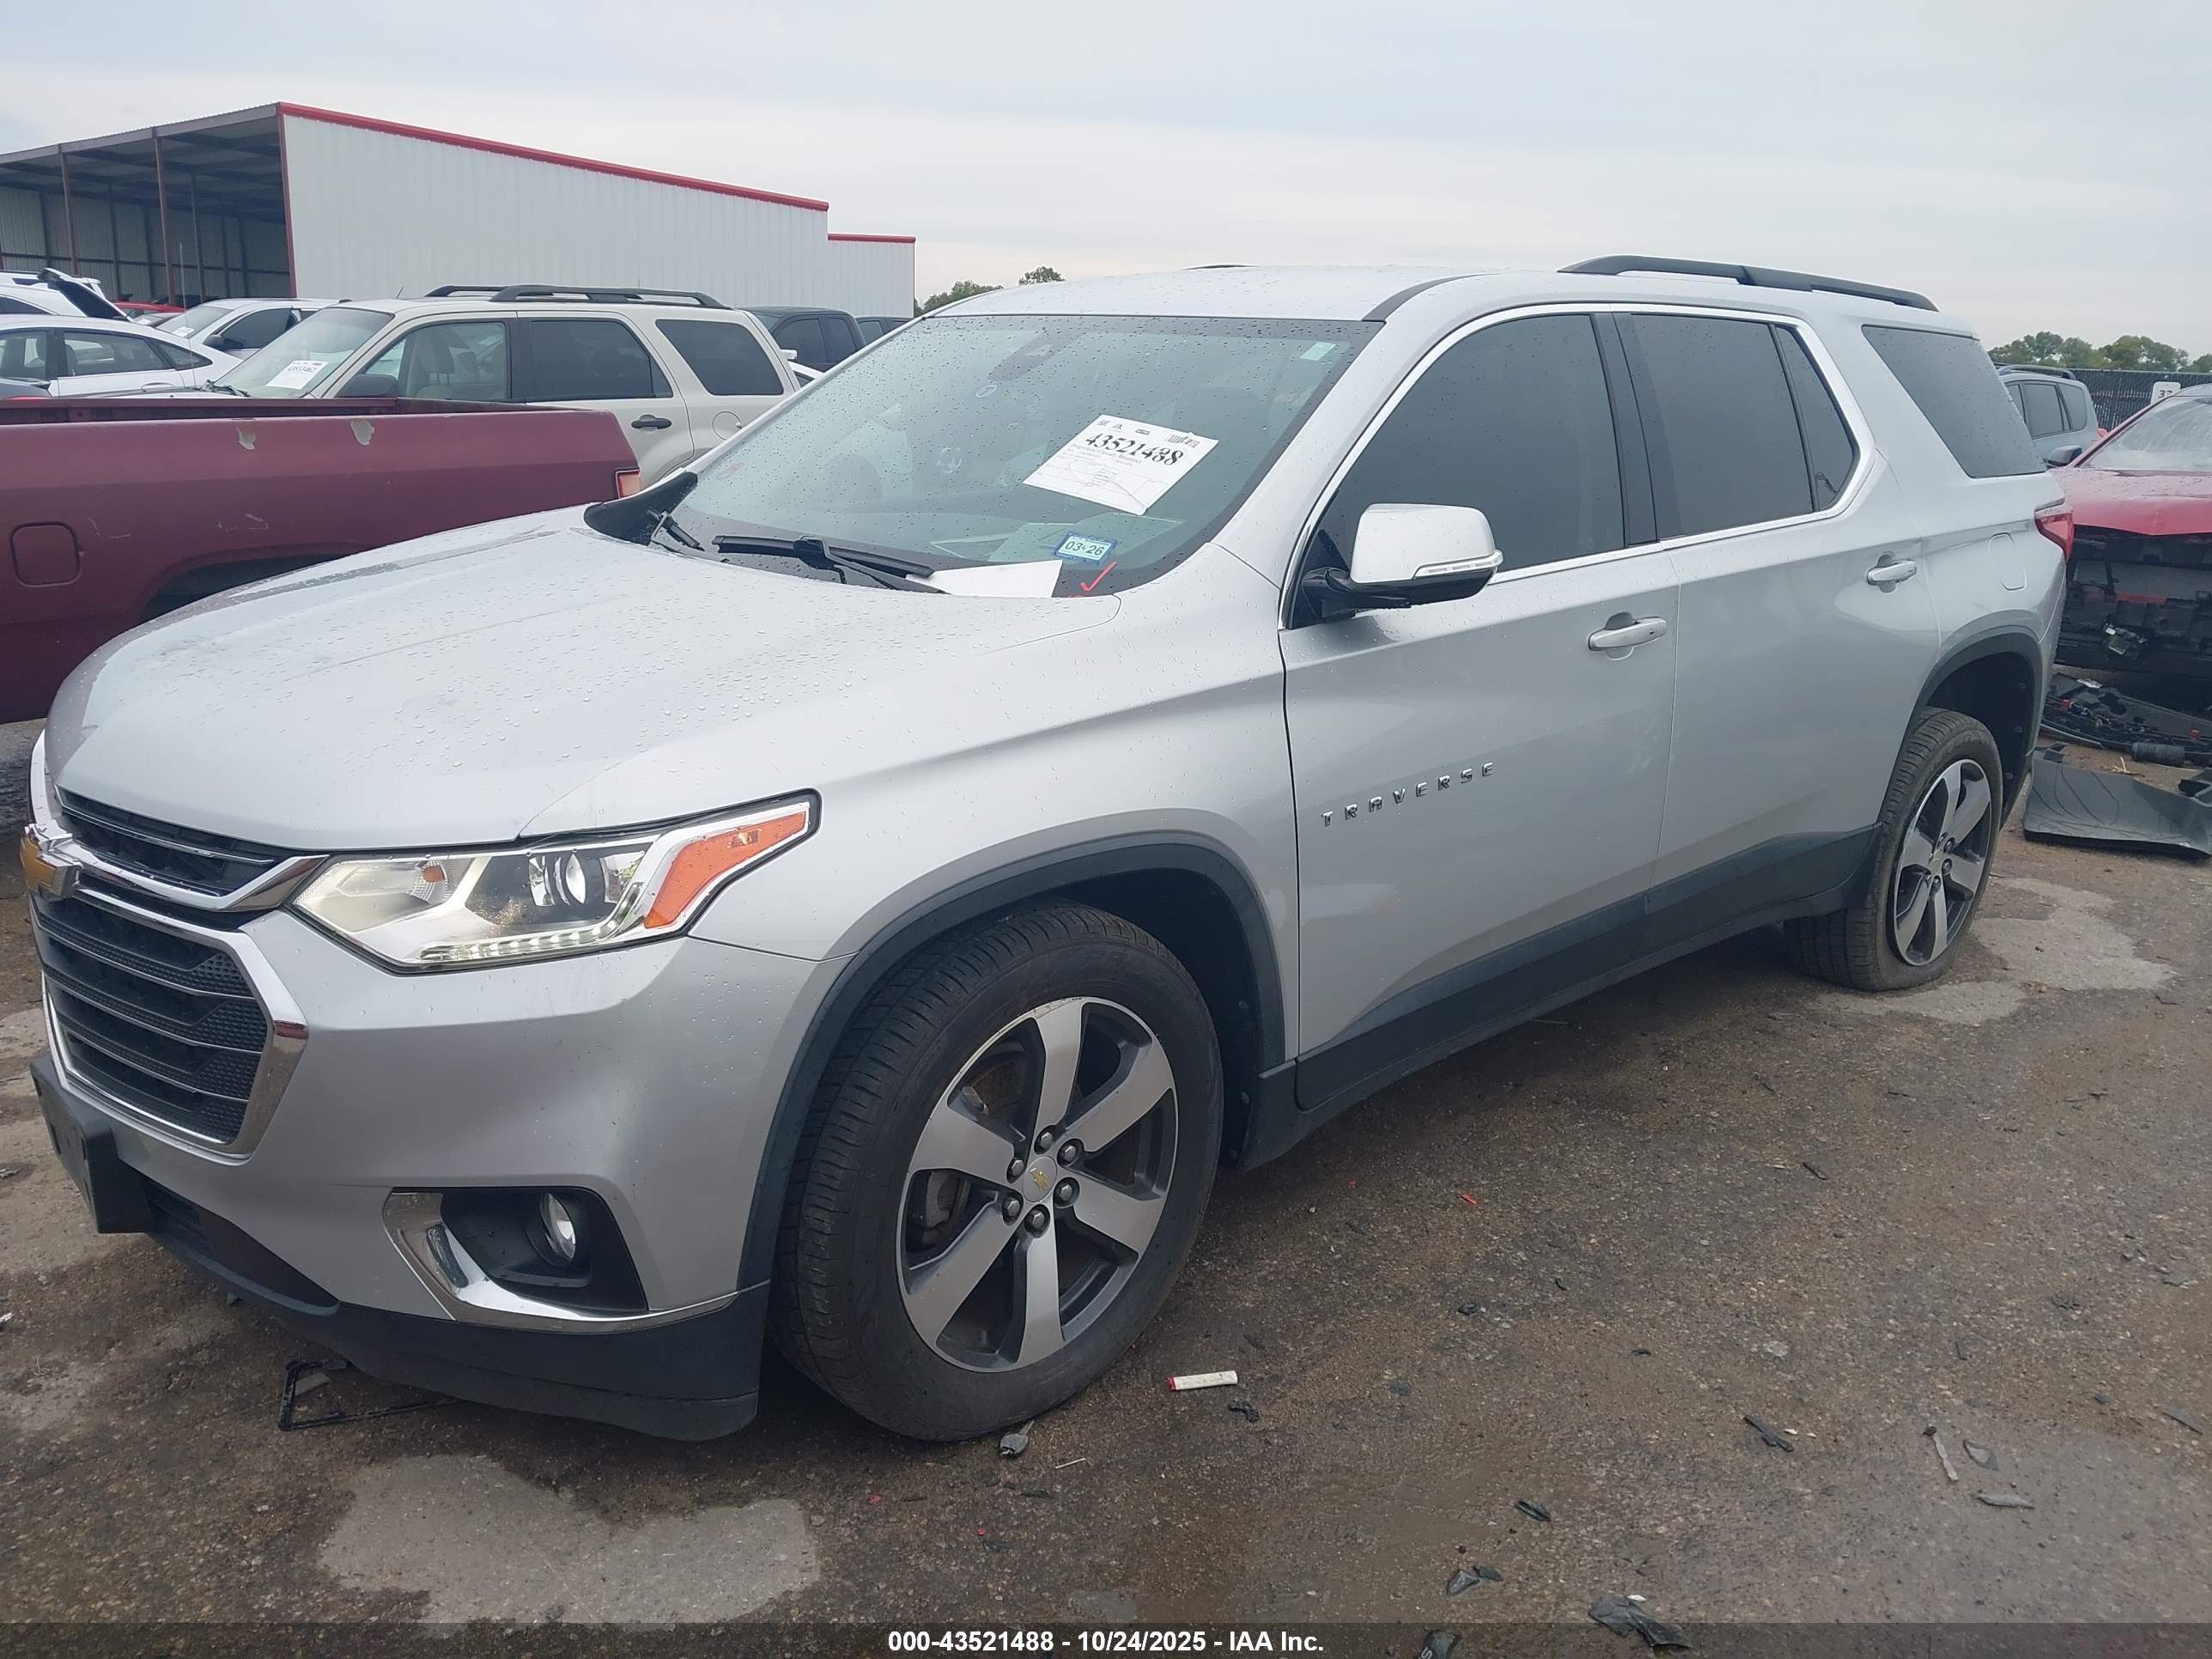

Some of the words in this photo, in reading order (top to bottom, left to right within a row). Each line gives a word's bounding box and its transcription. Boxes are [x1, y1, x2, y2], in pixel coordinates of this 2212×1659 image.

[1085, 433, 1184, 466] 43521488
[1065, 541, 1084, 551] 03
[1085, 544, 1105, 556] 26
[1321, 762, 1494, 827] TRAVERSE
